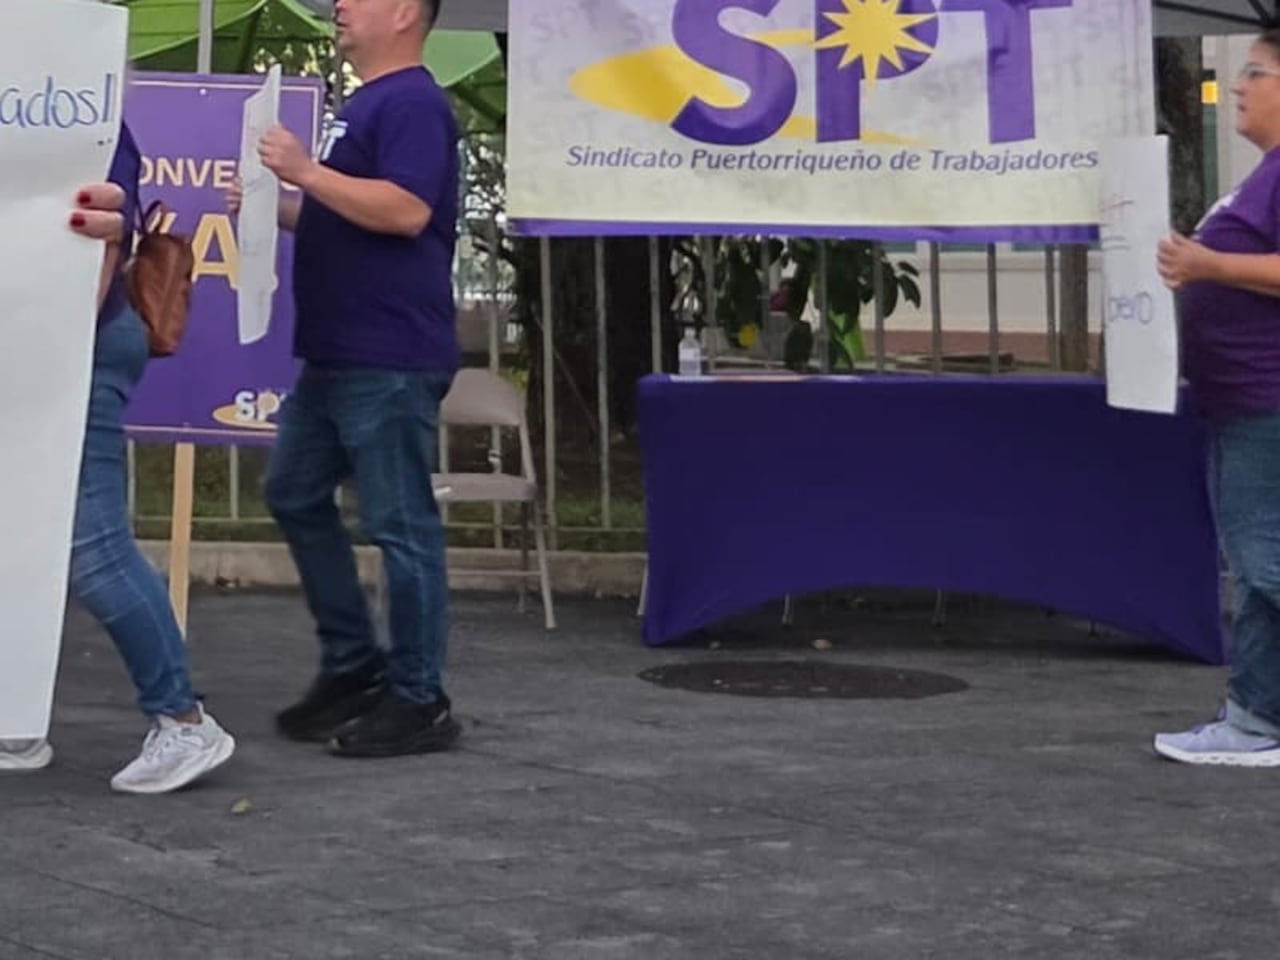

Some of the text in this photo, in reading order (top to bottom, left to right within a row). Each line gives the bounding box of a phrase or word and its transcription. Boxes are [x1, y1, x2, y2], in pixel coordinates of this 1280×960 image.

[566, 145, 1100, 176] Sindicato Puertorriqueño de Trabajadores
